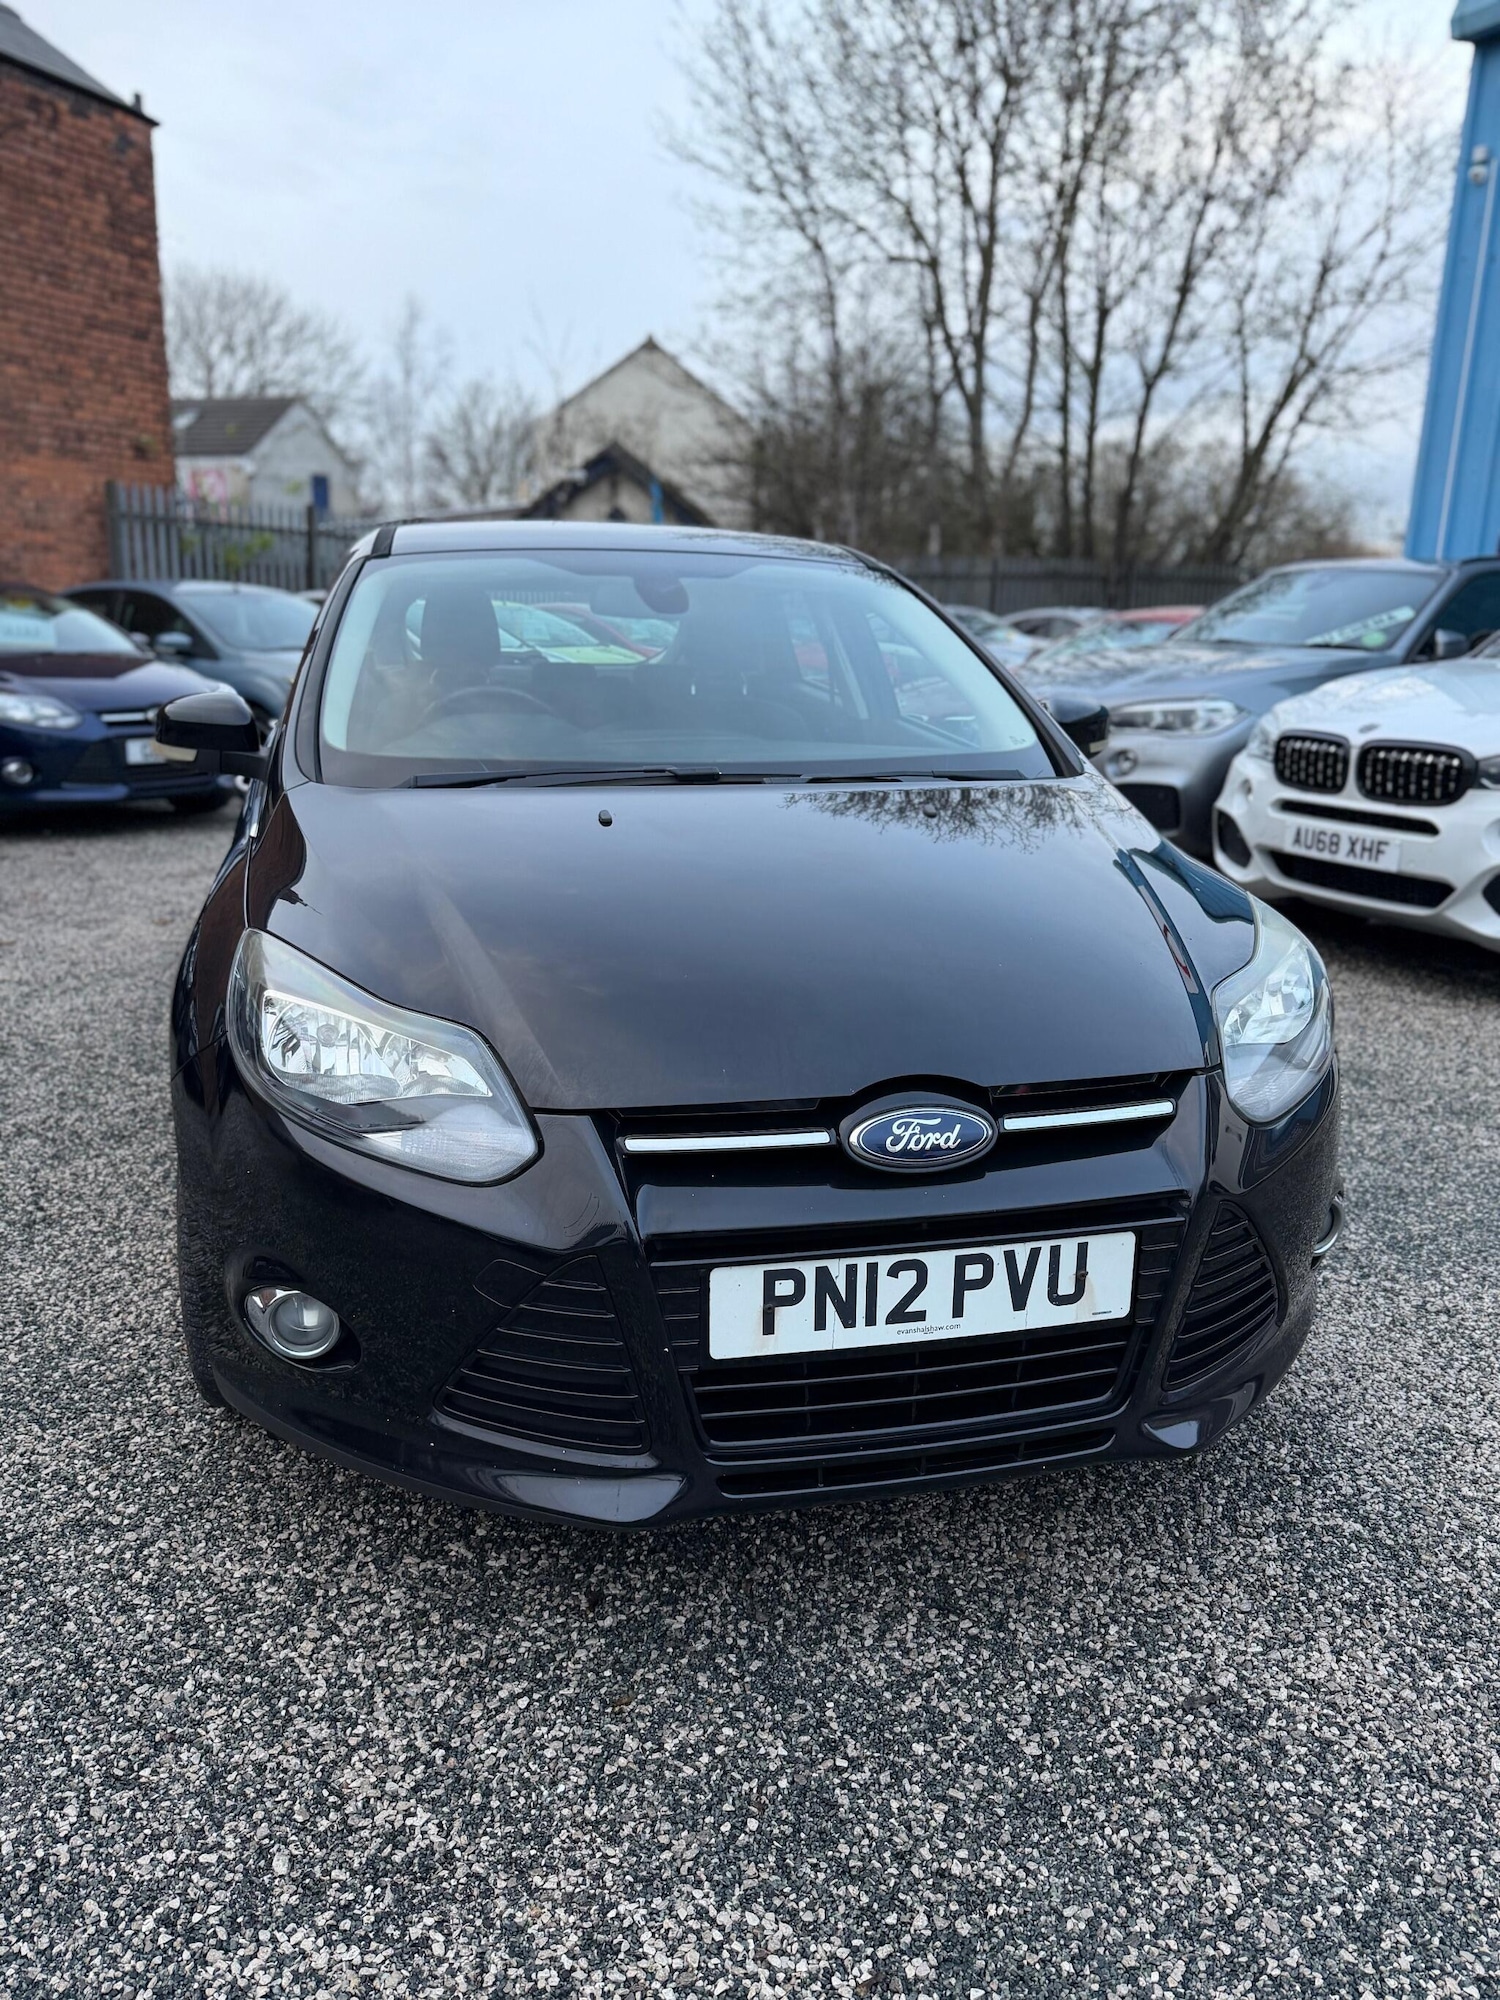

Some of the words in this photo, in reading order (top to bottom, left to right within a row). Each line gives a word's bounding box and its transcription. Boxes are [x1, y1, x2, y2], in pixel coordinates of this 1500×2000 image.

[1292, 826, 1341, 855] AU68
[1346, 836, 1390, 862] XHF
[886, 1118, 961, 1153] Ford
[762, 1258, 929, 1336] PN12
[952, 1241, 1089, 1319] PVU
[896, 1323, 961, 1335] evanshalshaw.com
